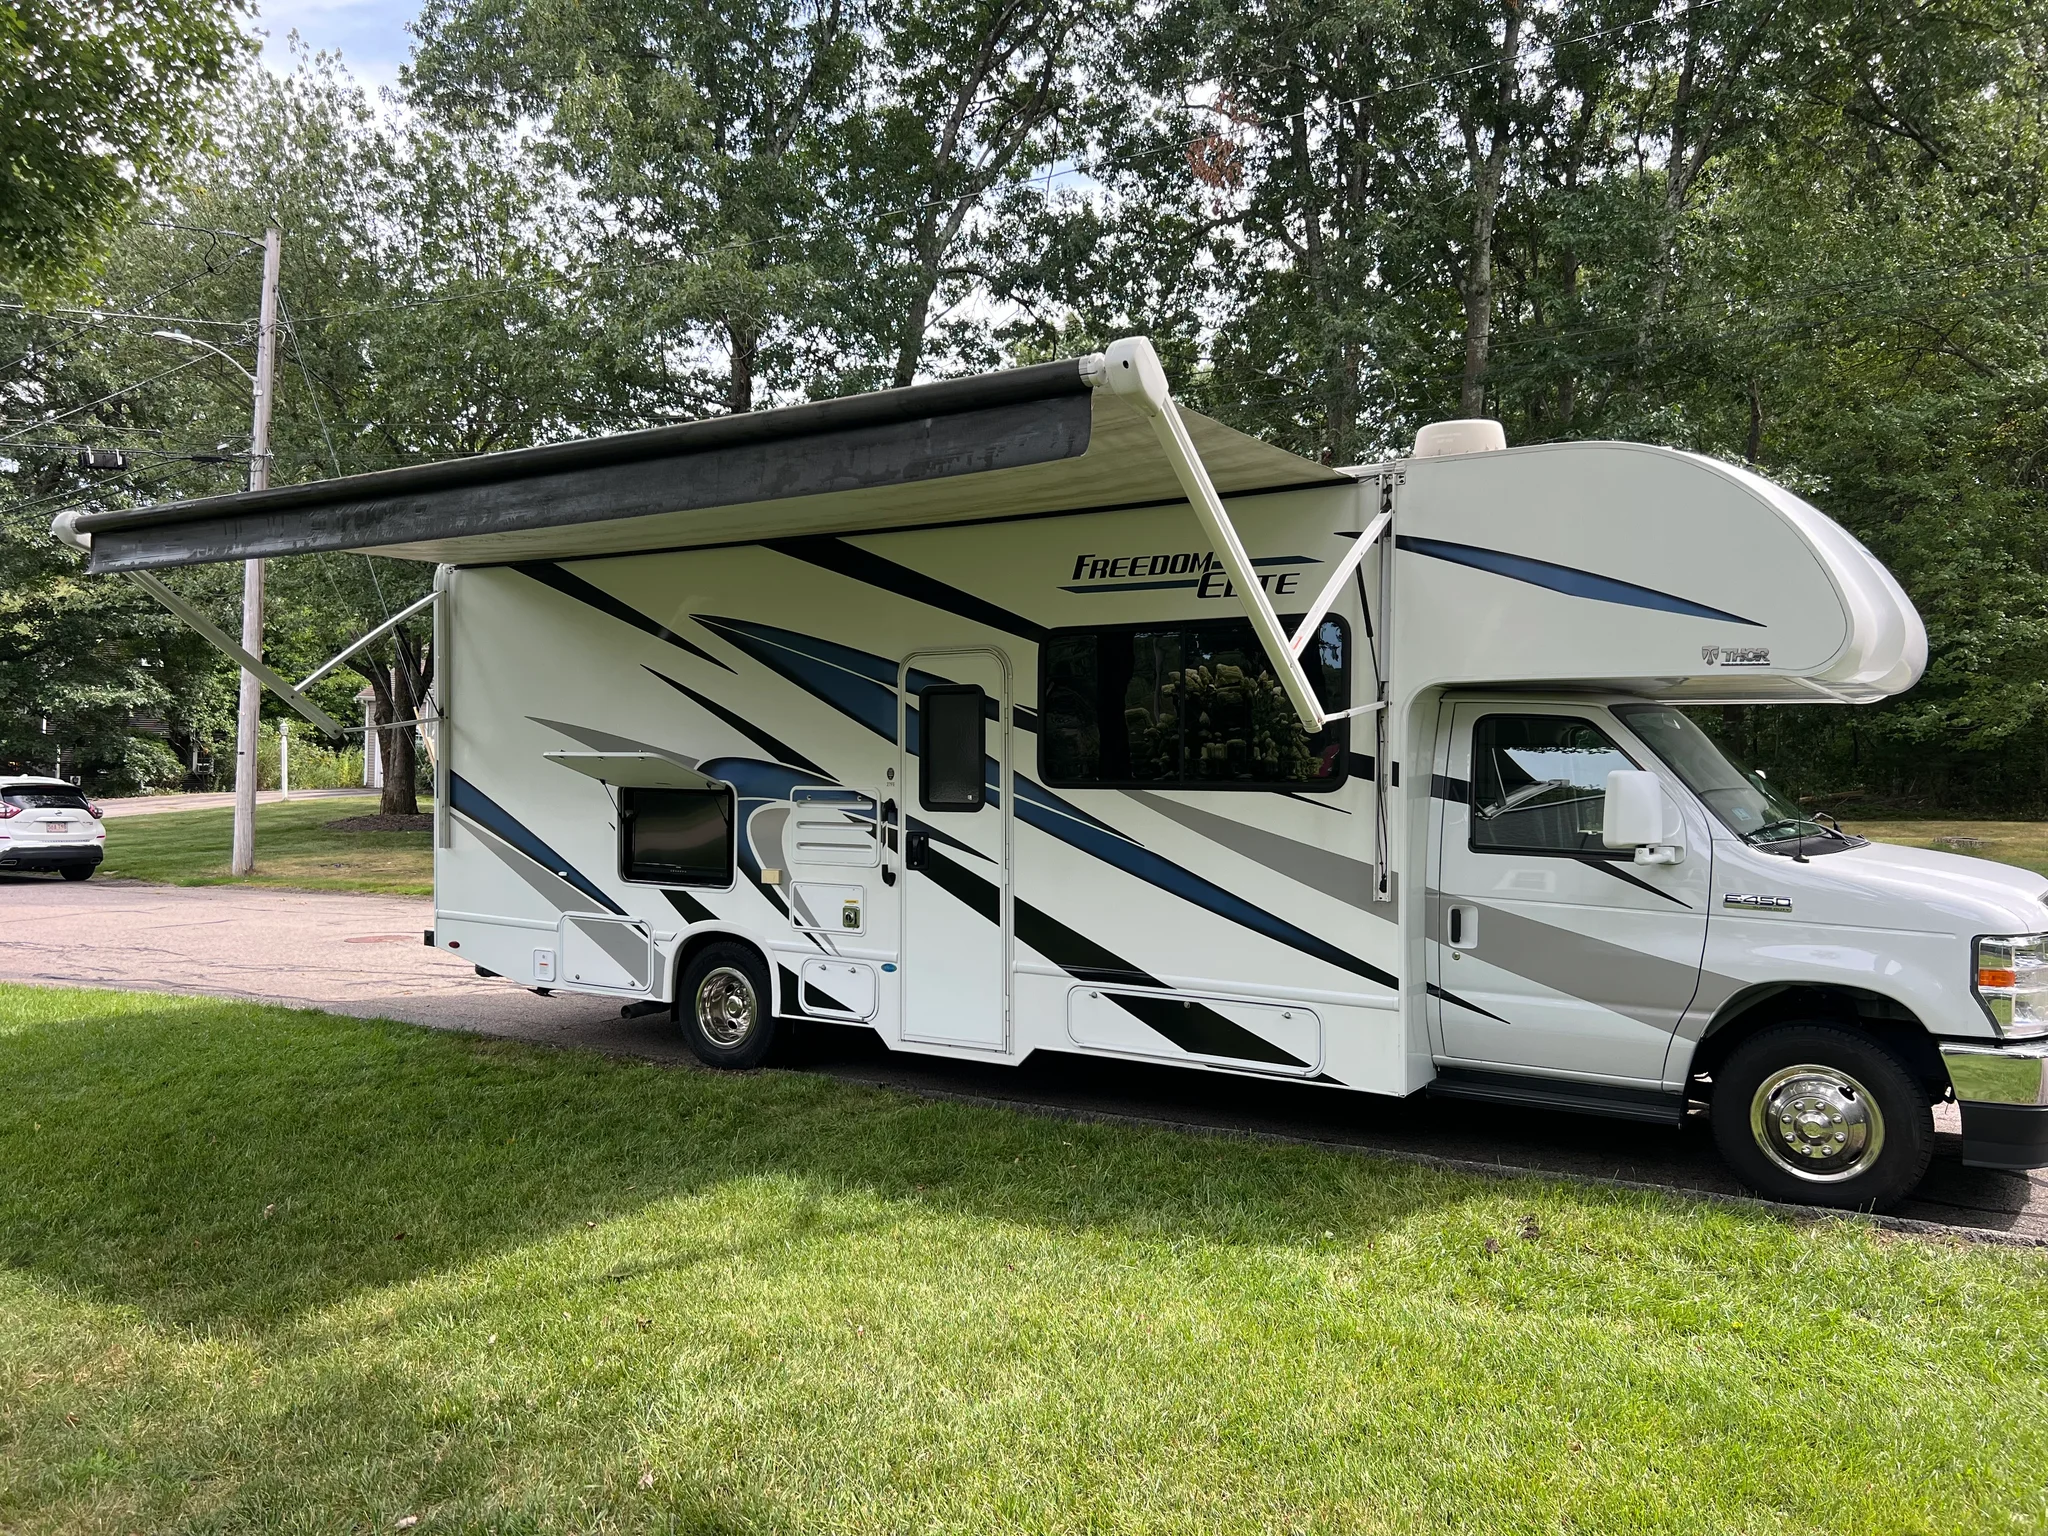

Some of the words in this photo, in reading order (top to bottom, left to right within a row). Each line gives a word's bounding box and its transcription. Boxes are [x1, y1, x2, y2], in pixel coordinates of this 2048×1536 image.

[1072, 551, 1214, 580] FREEDOM
[1196, 571, 1301, 599] ELTE
[1721, 648, 1770, 662] THOR
